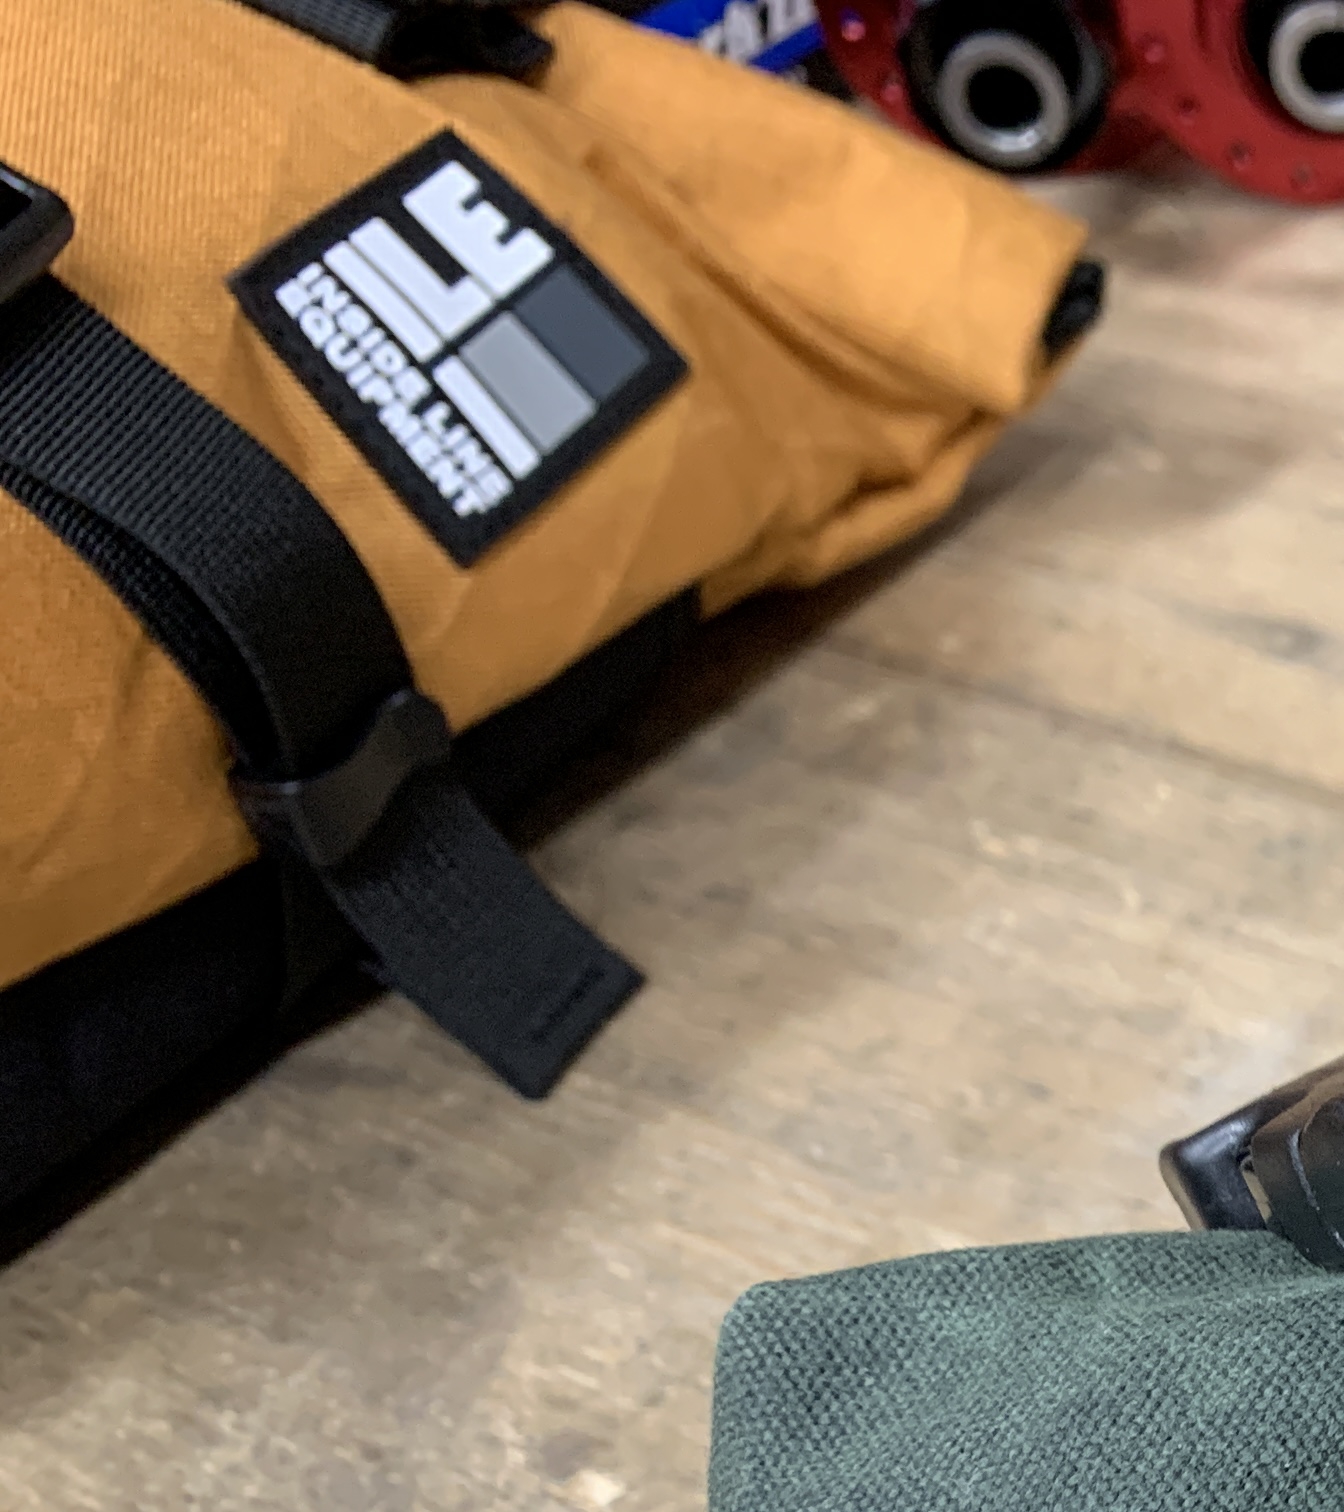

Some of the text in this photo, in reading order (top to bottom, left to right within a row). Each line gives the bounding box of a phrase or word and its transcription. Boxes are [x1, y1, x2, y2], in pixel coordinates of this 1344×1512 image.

[322, 160, 554, 363] ILE
[275, 282, 488, 518] EQUIPMENT
[297, 262, 514, 508] INSIDE LINE
